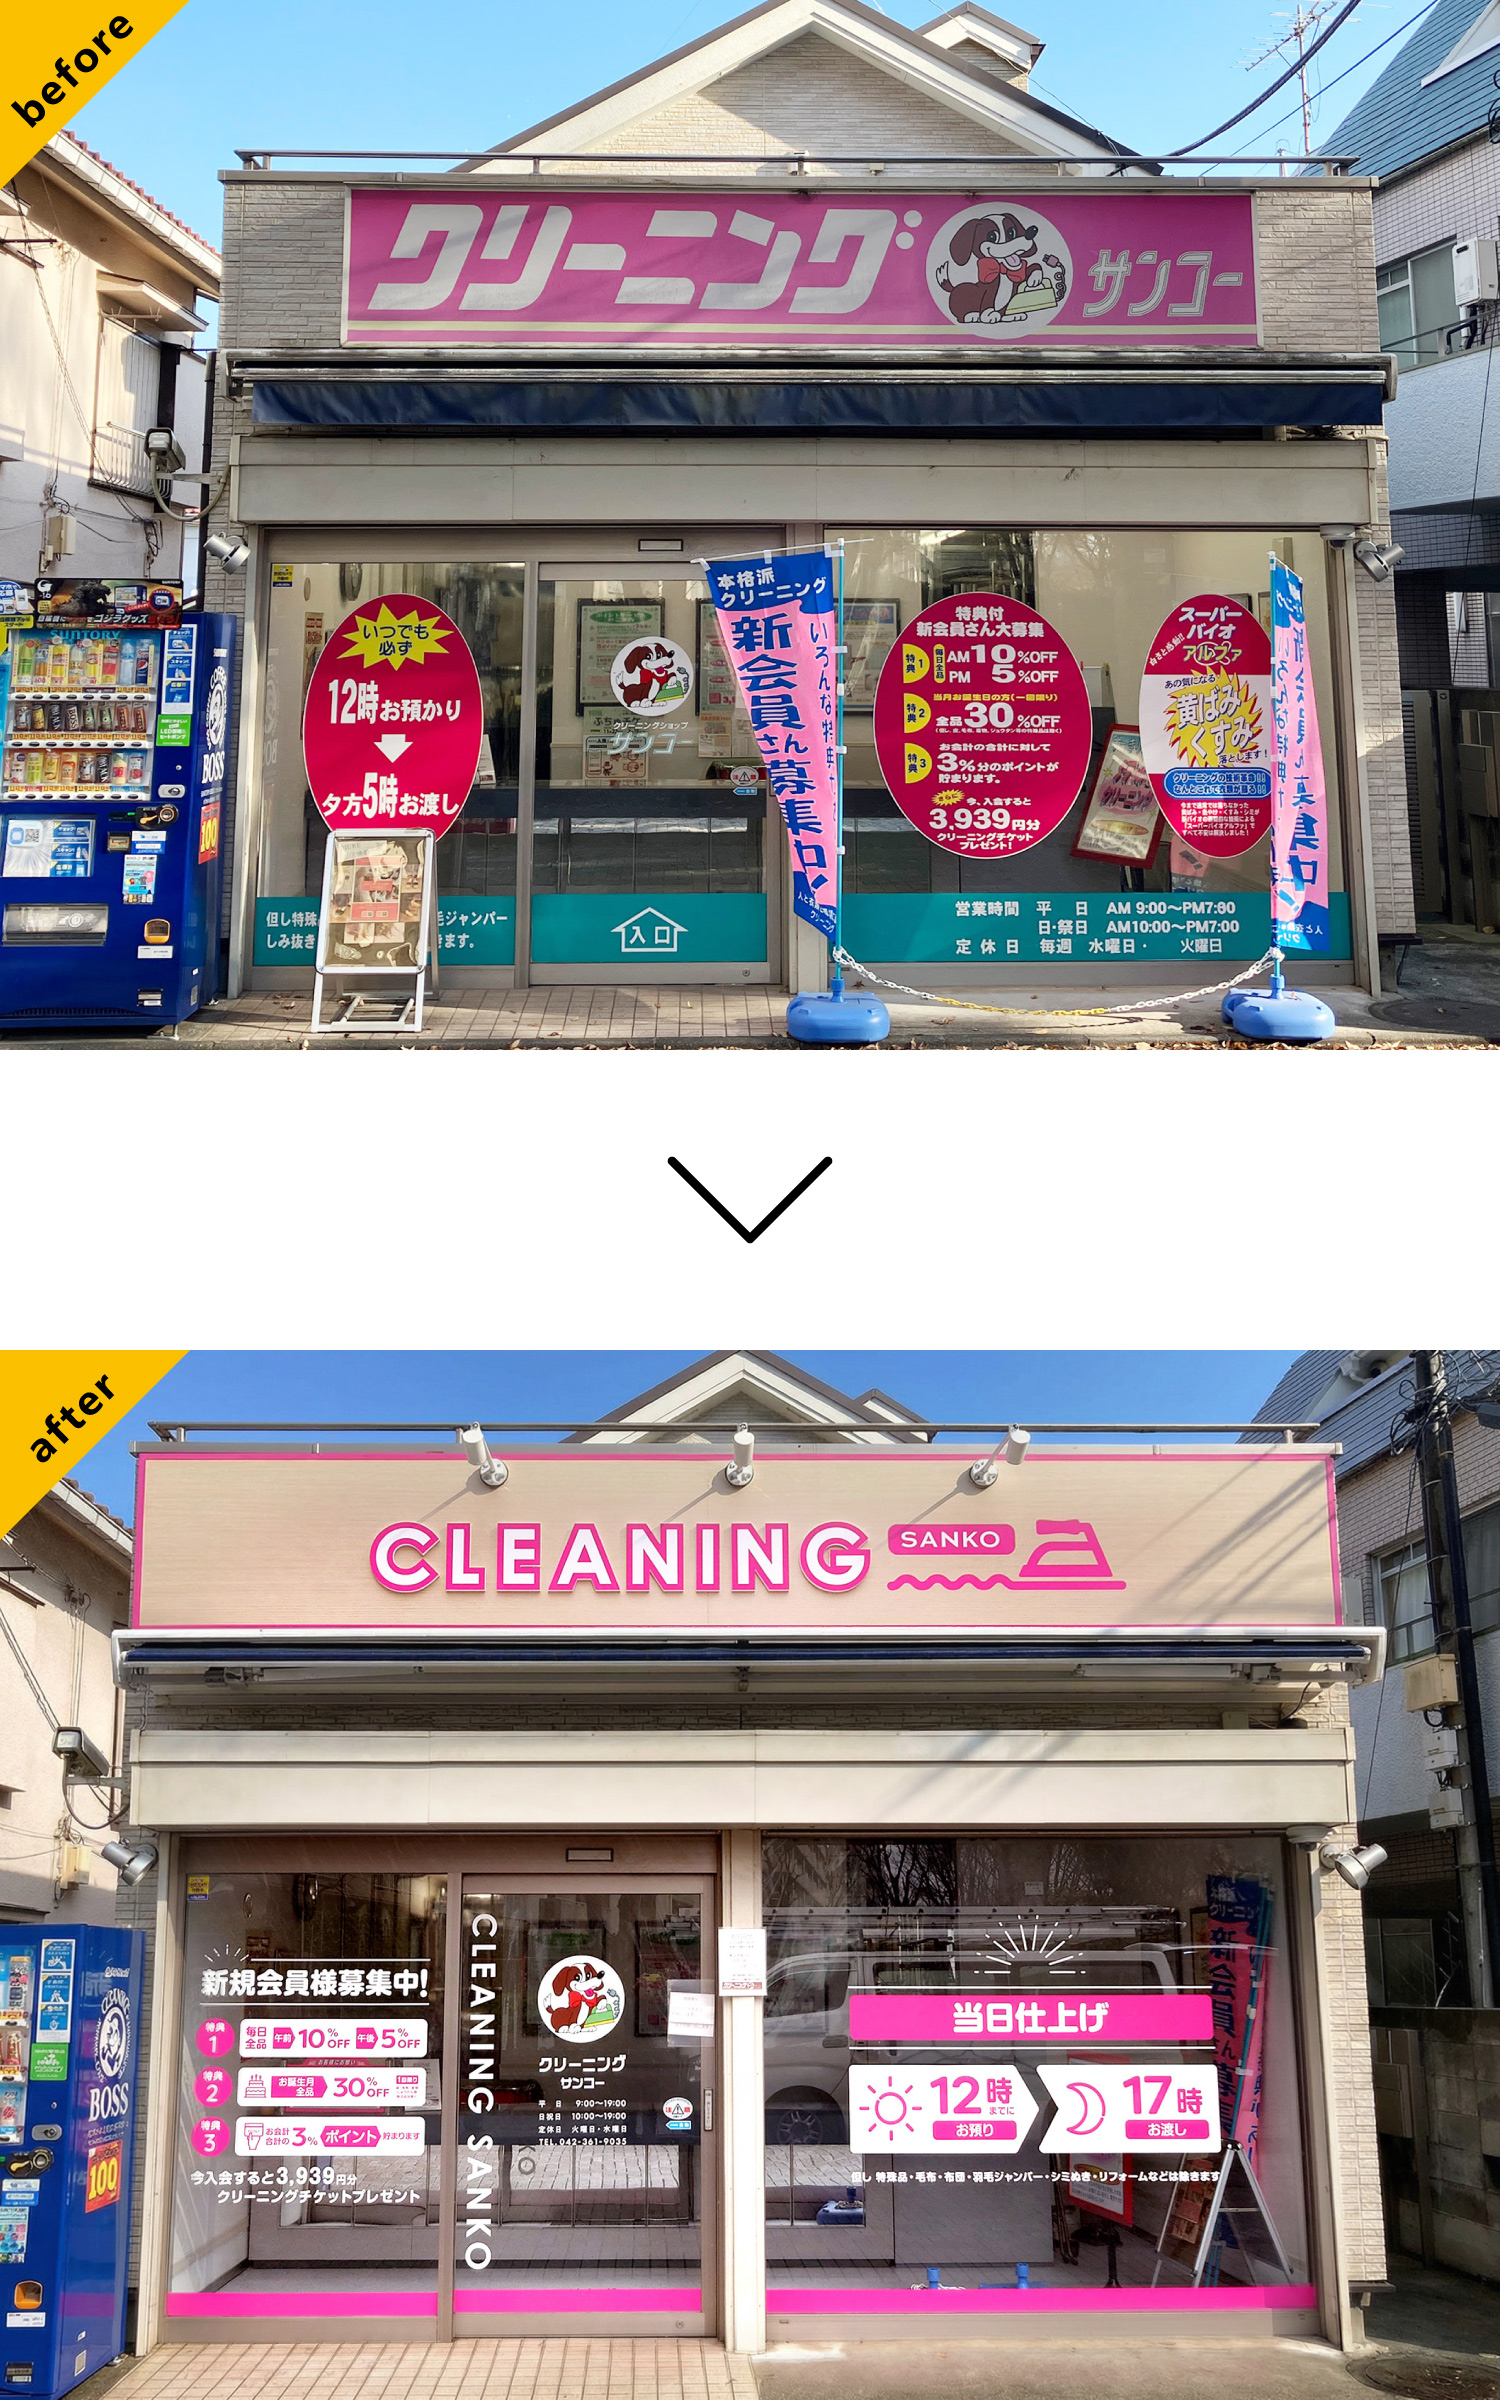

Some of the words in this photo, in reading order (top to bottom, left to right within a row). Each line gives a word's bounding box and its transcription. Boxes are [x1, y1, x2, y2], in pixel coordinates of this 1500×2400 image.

[366, 203, 922, 315] クリーニング
[1083, 249, 1243, 318] サンコー
[717, 567, 775, 591] 本格派
[720, 577, 827, 608] クリーニング
[955, 606, 1004, 621] 特典付
[1178, 605, 1243, 622] スーパー
[50, 630, 121, 640] SUNTORY
[363, 624, 430, 640] いつでも
[916, 622, 1045, 638] 新会員さん大募集
[1186, 622, 1237, 640] バイオ
[378, 641, 413, 656] 必ず
[1182, 645, 1243, 662] アルファ
[906, 654, 916, 674] 特典
[918, 659, 924, 669] 1
[935, 648, 945, 680] 毎日全品
[949, 671, 971, 684] PM
[1164, 674, 1216, 689] あの気になる
[328, 678, 461, 724] 12時お預かり
[1175, 681, 1242, 727] 黄ばみ
[907, 703, 917, 723] 特典
[918, 708, 925, 718] 2
[613, 722, 689, 730] クリーニングショップ
[607, 731, 694, 755] サンコー
[1191, 716, 1254, 759] くすみ
[731, 612, 830, 896] 新会員さん募集中!
[939, 743, 1051, 751] お会計の合計に対して
[908, 753, 917, 773] 特典
[920, 758, 926, 768] 3
[1219, 749, 1268, 763] 落とします!
[201, 751, 225, 784] BOSS
[938, 773, 1001, 783] 貯まります。
[322, 772, 460, 819] 夕方5時お渡し
[966, 797, 1031, 806] 今、入会すると
[928, 808, 1040, 830] 3,939円分
[200, 817, 217, 853] 100
[937, 833, 1034, 842] クリーニングチケット
[959, 841, 1013, 851] プレゼント!
[955, 901, 1019, 917] 営業時間
[1106, 902, 1131, 915] AM
[266, 911, 319, 927] 但し特殊
[266, 933, 315, 950] しみ抜き
[629, 926, 670, 945] 入口
[955, 938, 1020, 954] 定休日
[1039, 938, 1073, 954] 毎週
[1180, 938, 1223, 954] 火曜日
[369, 1521, 872, 1595] CLEANING
[899, 1529, 1001, 1549] SANKO
[200, 1968, 429, 1998] 新規会員様募集中!
[467, 1913, 498, 2114] CLEANING
[952, 2002, 1109, 2034] 当日仕上げ
[205, 2022, 225, 2033] 特典
[245, 2026, 267, 2037] 毎日
[208, 2035, 217, 2053] 1
[245, 2038, 267, 2049] 全品
[274, 2033, 292, 2043] 午前
[298, 2028, 326, 2048] 10
[357, 2033, 375, 2043] 午後
[381, 2029, 396, 2048] 5
[327, 2039, 350, 2048] OFF
[397, 2039, 421, 2048] OFF
[538, 2054, 627, 2073] クリーニング
[203, 2071, 223, 2081] 特典
[560, 2077, 605, 2090] サンコー
[206, 2083, 219, 2102] 2
[278, 2077, 315, 2087] お誕生月
[332, 2077, 366, 2097] 30
[295, 2087, 315, 2097] 全品
[366, 2088, 390, 2097] OFF
[1122, 2075, 1203, 2115] 17時
[88, 2082, 129, 2122] BOSS
[538, 2112, 562, 2121] 日祝日
[989, 2106, 1015, 2116] までに
[200, 2121, 221, 2131] 特典
[538, 2125, 562, 2133] 定休日
[955, 2122, 994, 2138] お預り
[1147, 2122, 1188, 2137] お渡し
[203, 2134, 217, 2152] 3
[265, 2137, 290, 2145] 合計の
[325, 2130, 377, 2144] ポイント
[382, 2132, 420, 2140] 貯まります
[88, 2156, 118, 2201] 100
[190, 2166, 358, 2186] 今入会すると3,939円分
[850, 2171, 872, 2182] 但し
[217, 2189, 421, 2204] クリーニングチケットプレゼント
[464, 2133, 493, 2271] SANKO
